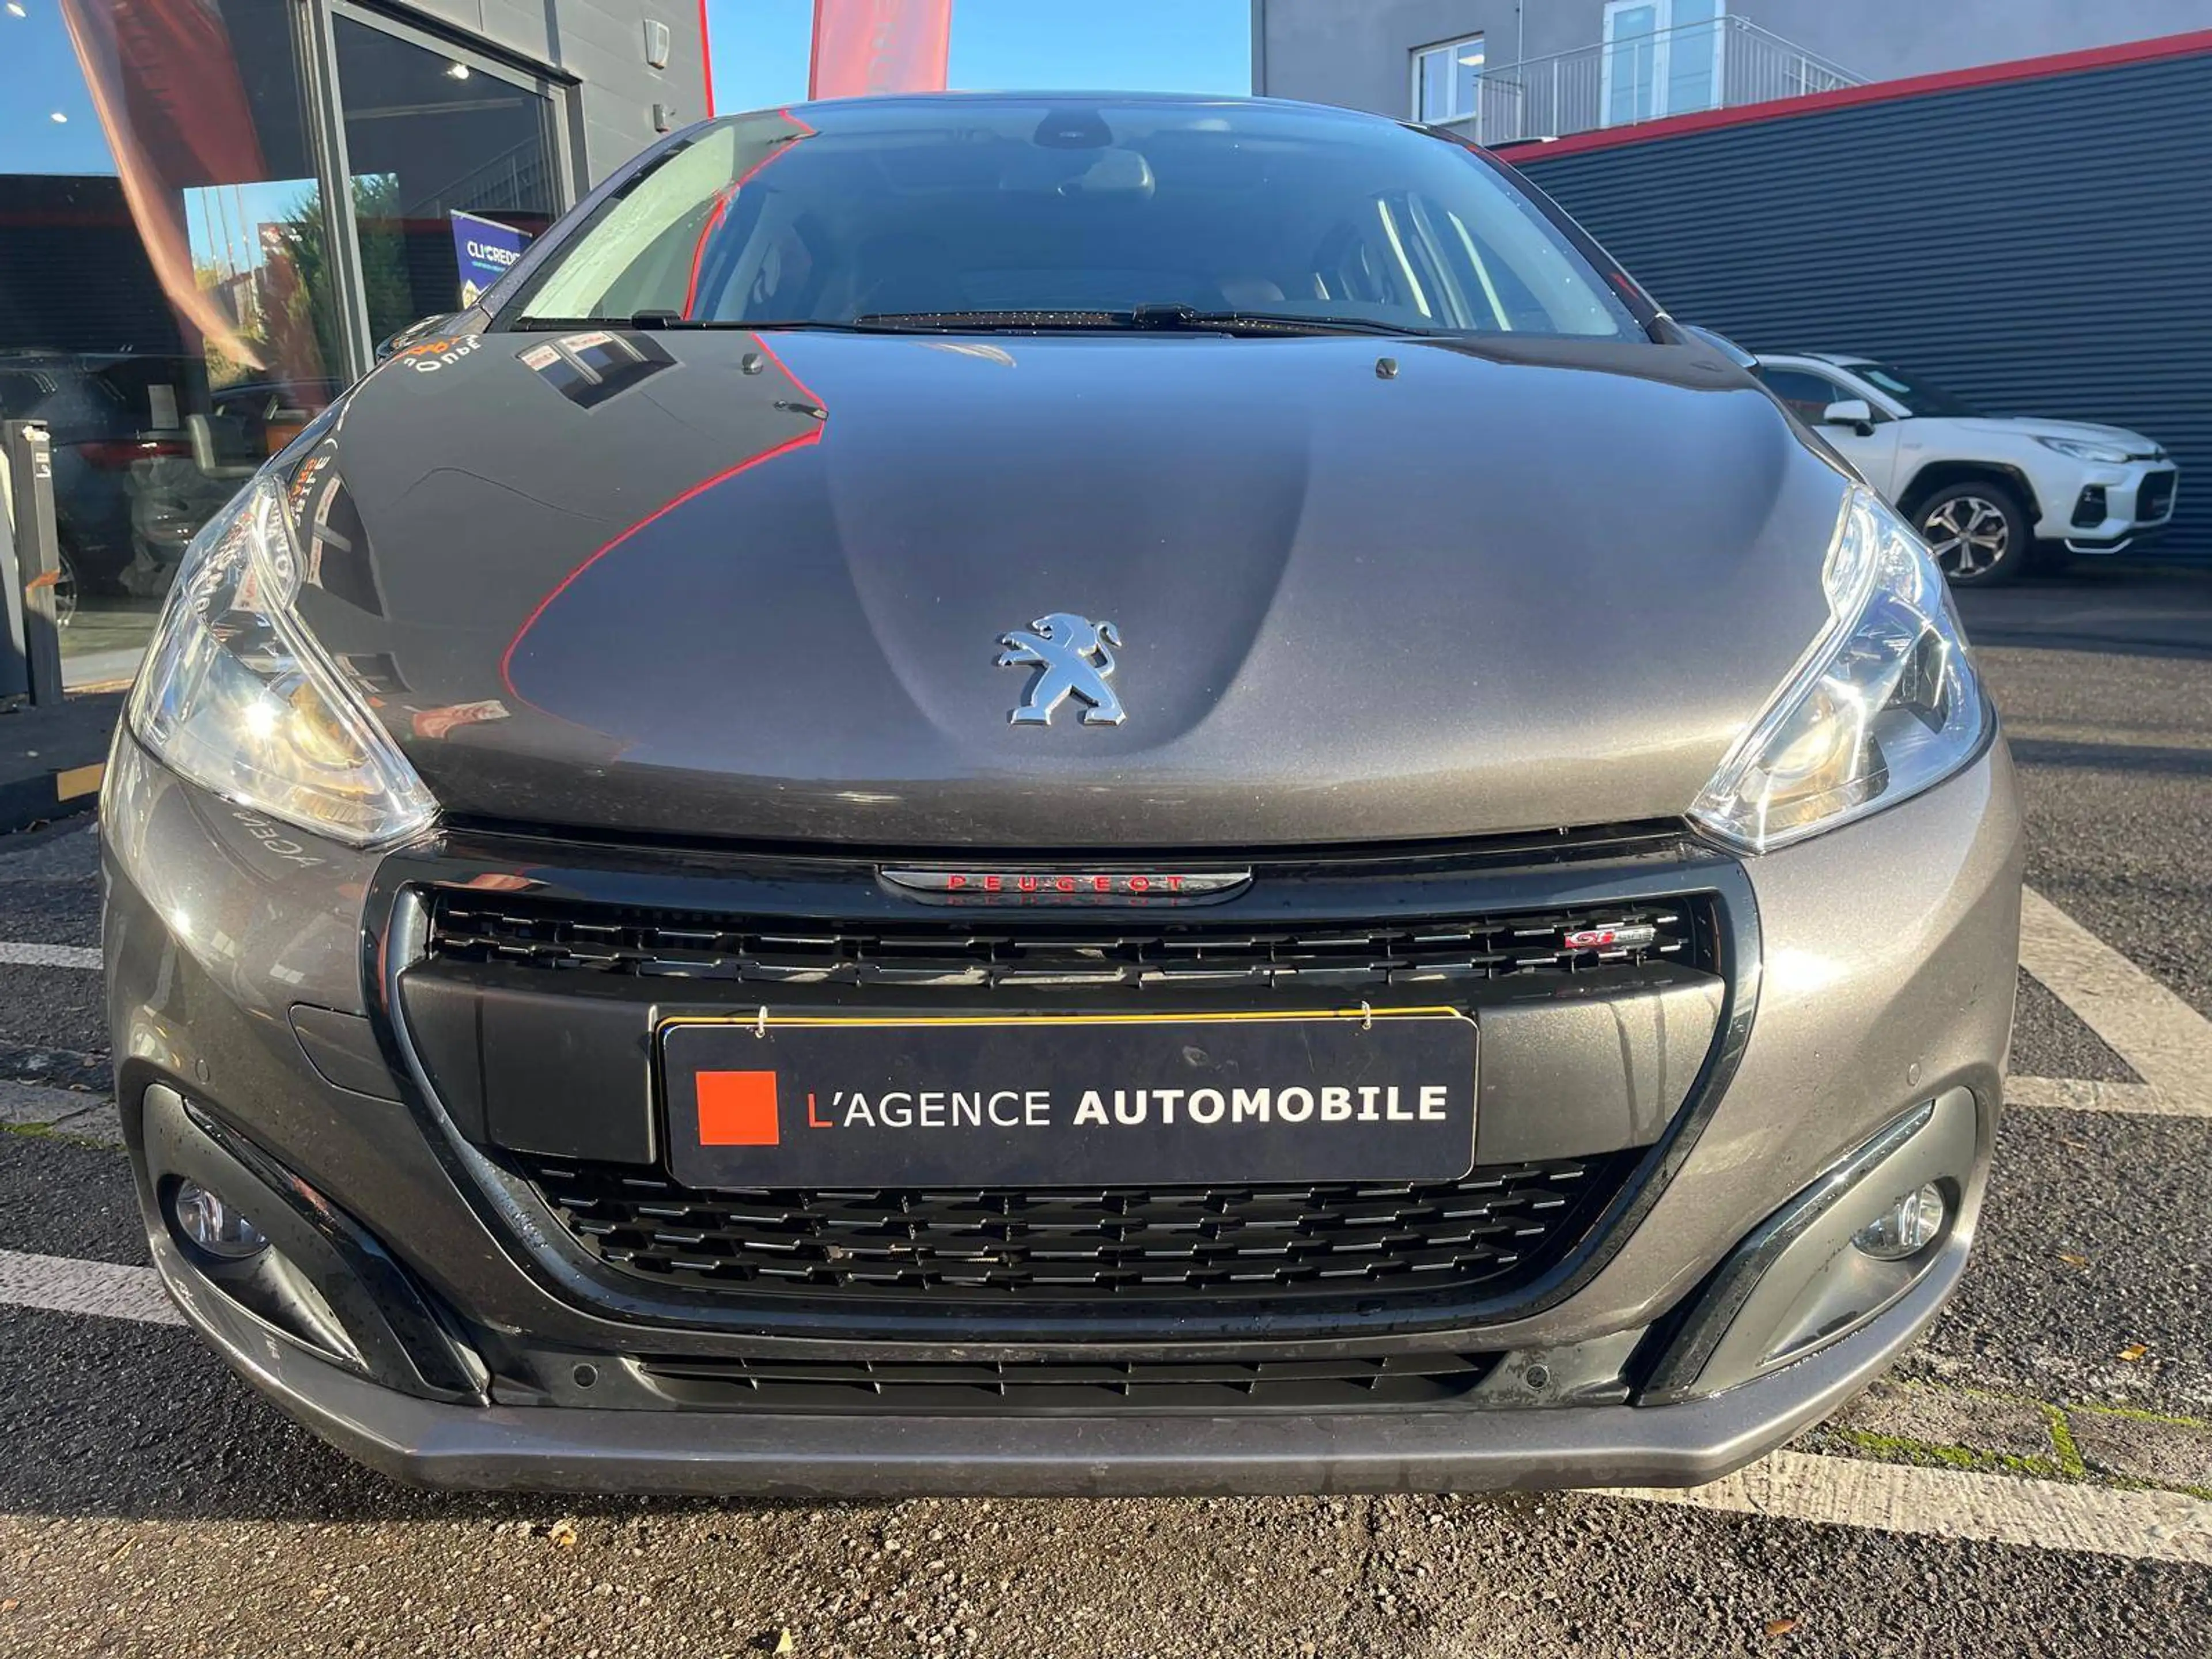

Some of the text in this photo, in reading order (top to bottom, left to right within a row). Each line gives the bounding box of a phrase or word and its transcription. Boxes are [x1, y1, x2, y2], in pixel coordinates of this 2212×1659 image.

[948, 875, 1184, 892] PEUGEOT
[807, 1085, 1448, 1128] L'AGENCE AUTOMOBILE
